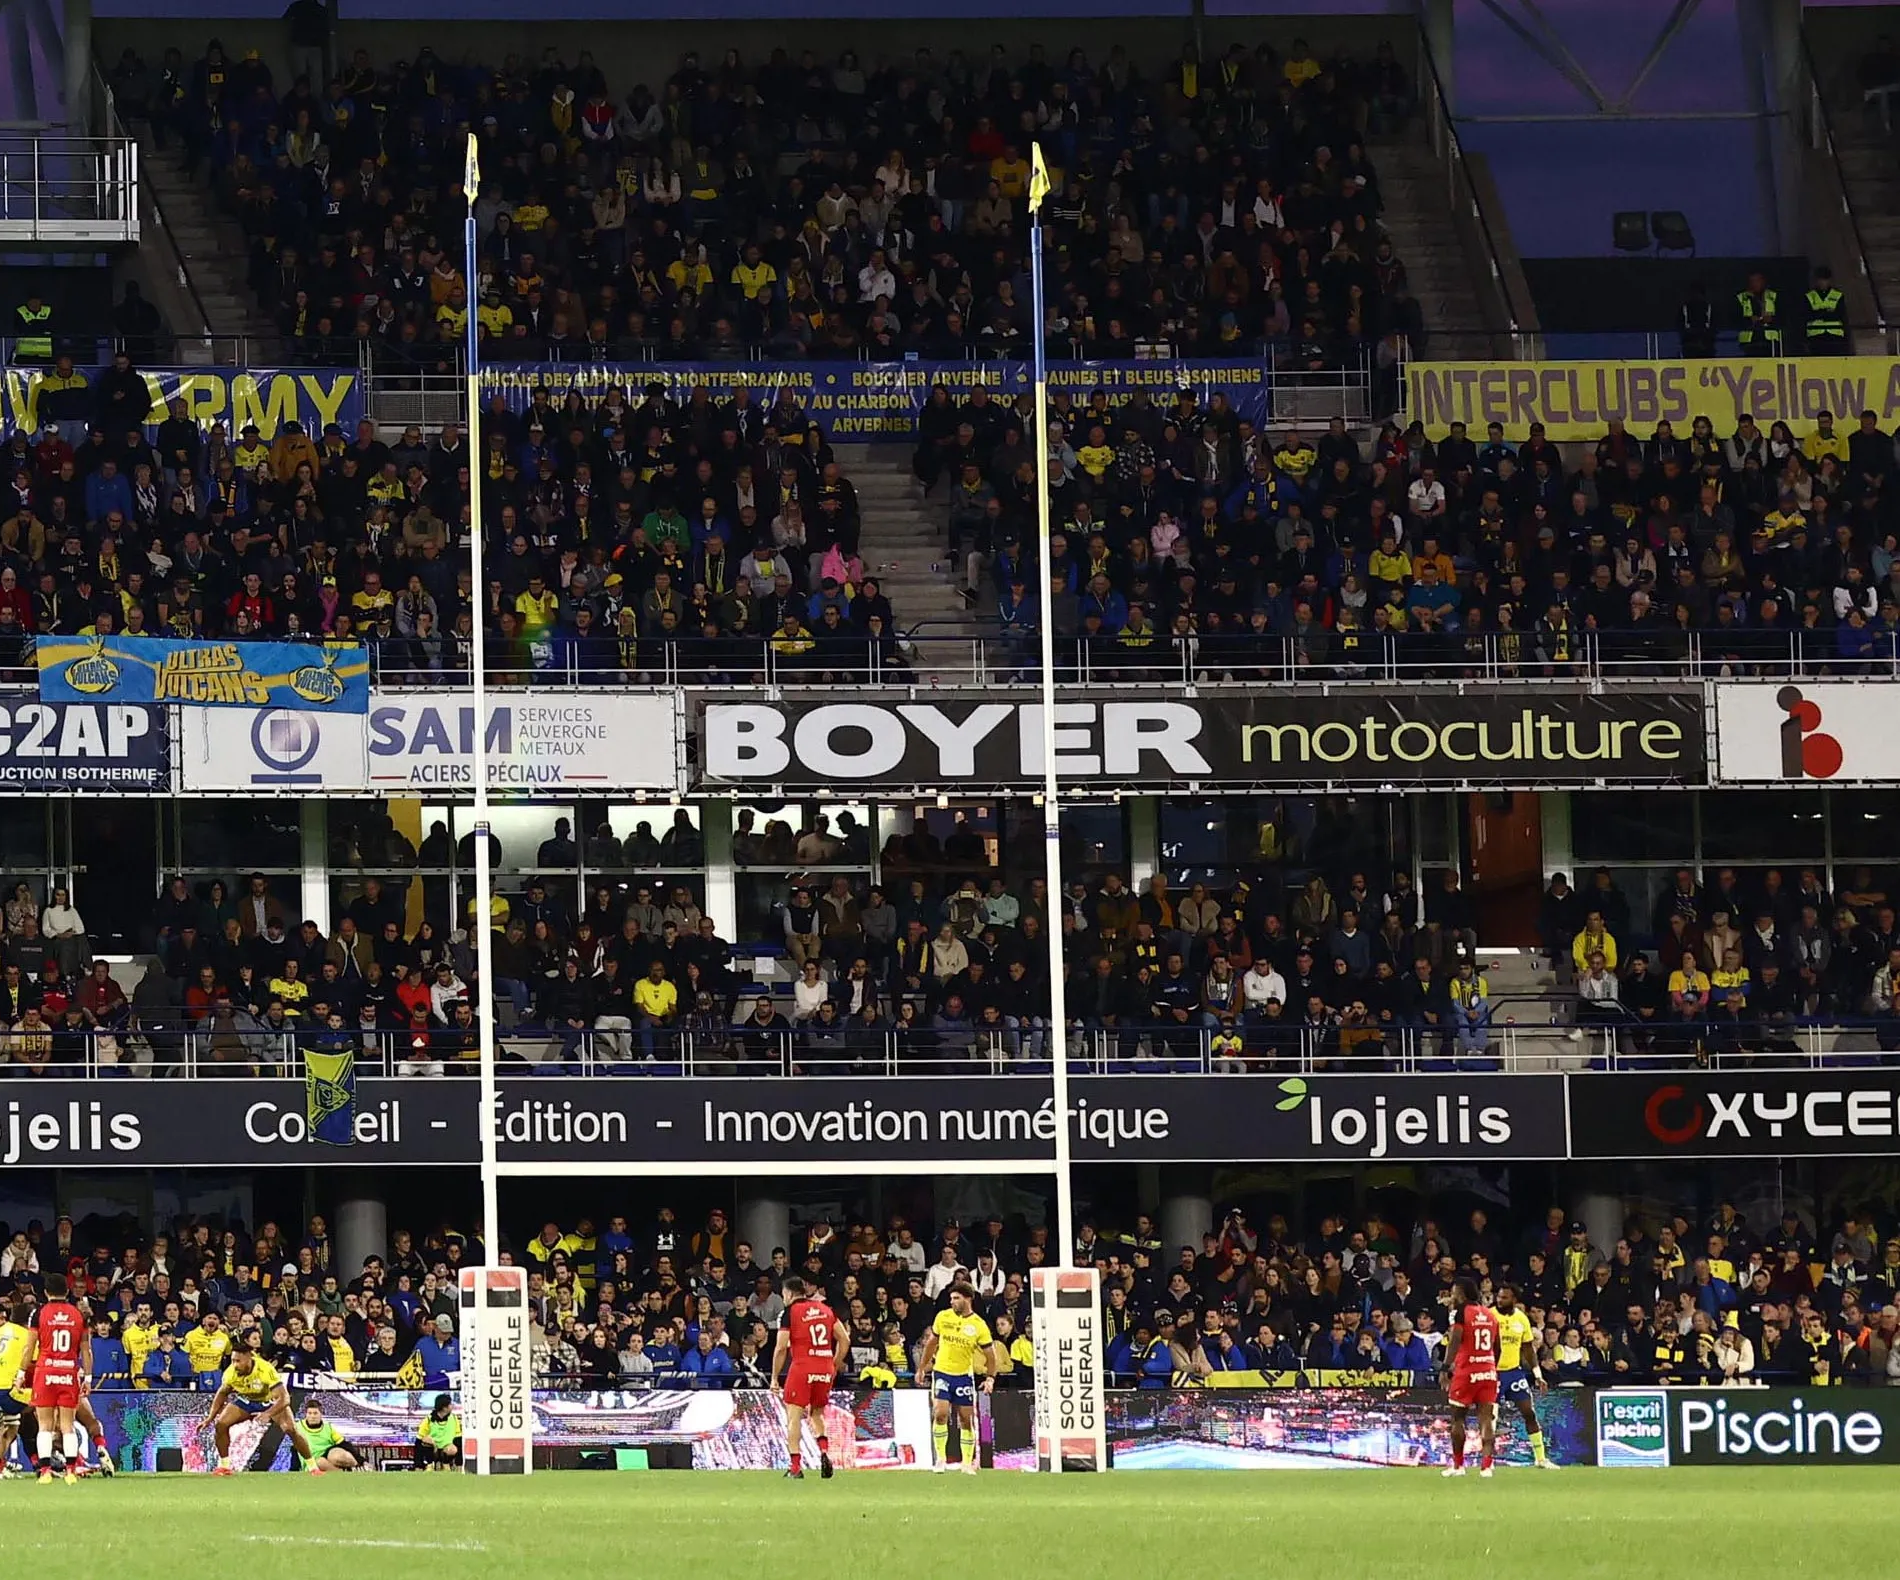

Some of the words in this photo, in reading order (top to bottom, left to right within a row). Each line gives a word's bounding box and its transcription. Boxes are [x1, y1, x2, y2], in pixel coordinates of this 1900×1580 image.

[543, 372, 571, 387] DES
[574, 371, 672, 388] SUPPORTERS
[677, 371, 813, 387] MONTFERRANDAIS
[931, 371, 1001, 387] ARVERNE
[1046, 370, 1099, 385] AUNES
[1103, 369, 1121, 385] ET
[1125, 370, 1175, 385] BLEUS
[812, 395, 832, 409] AU
[837, 394, 910, 410] CHARBON
[1411, 367, 1687, 424] INTERCLUBS
[832, 417, 911, 432] ARVERNES
[166, 643, 243, 671] ULTRAS
[154, 660, 271, 704] VULCANS
[518, 707, 592, 722] SERVICES
[368, 706, 513, 755] SAM
[518, 724, 608, 739] AUVERGNE
[705, 702, 1213, 778] BOYER
[1242, 709, 1683, 762] motoculture
[519, 741, 586, 755] METAUX
[61, 767, 158, 782] ISOTHERME
[410, 764, 471, 783] ACIERS
[487, 761, 562, 783] PÉCIAUX
[245, 1100, 399, 1143] Coeil
[479, 1090, 627, 1143] Édition
[704, 1100, 928, 1142] Innovation
[1310, 1095, 1511, 1157] lojelis
[1645, 1085, 1900, 1144] OXYCE
[52, 1329, 71, 1353] 10
[809, 1323, 829, 1347] 12
[1474, 1328, 1491, 1351] 13
[45, 1373, 73, 1385] yack
[489, 1337, 504, 1430] SOCIETE
[508, 1315, 523, 1430] GENERALE
[807, 1373, 832, 1384] yack
[1059, 1337, 1075, 1430] SOCIETE
[1078, 1316, 1094, 1430] GENERALE
[1603, 1400, 1661, 1421] l'esprit
[1604, 1420, 1662, 1440] piscine
[1681, 1398, 1883, 1455] Piscine
